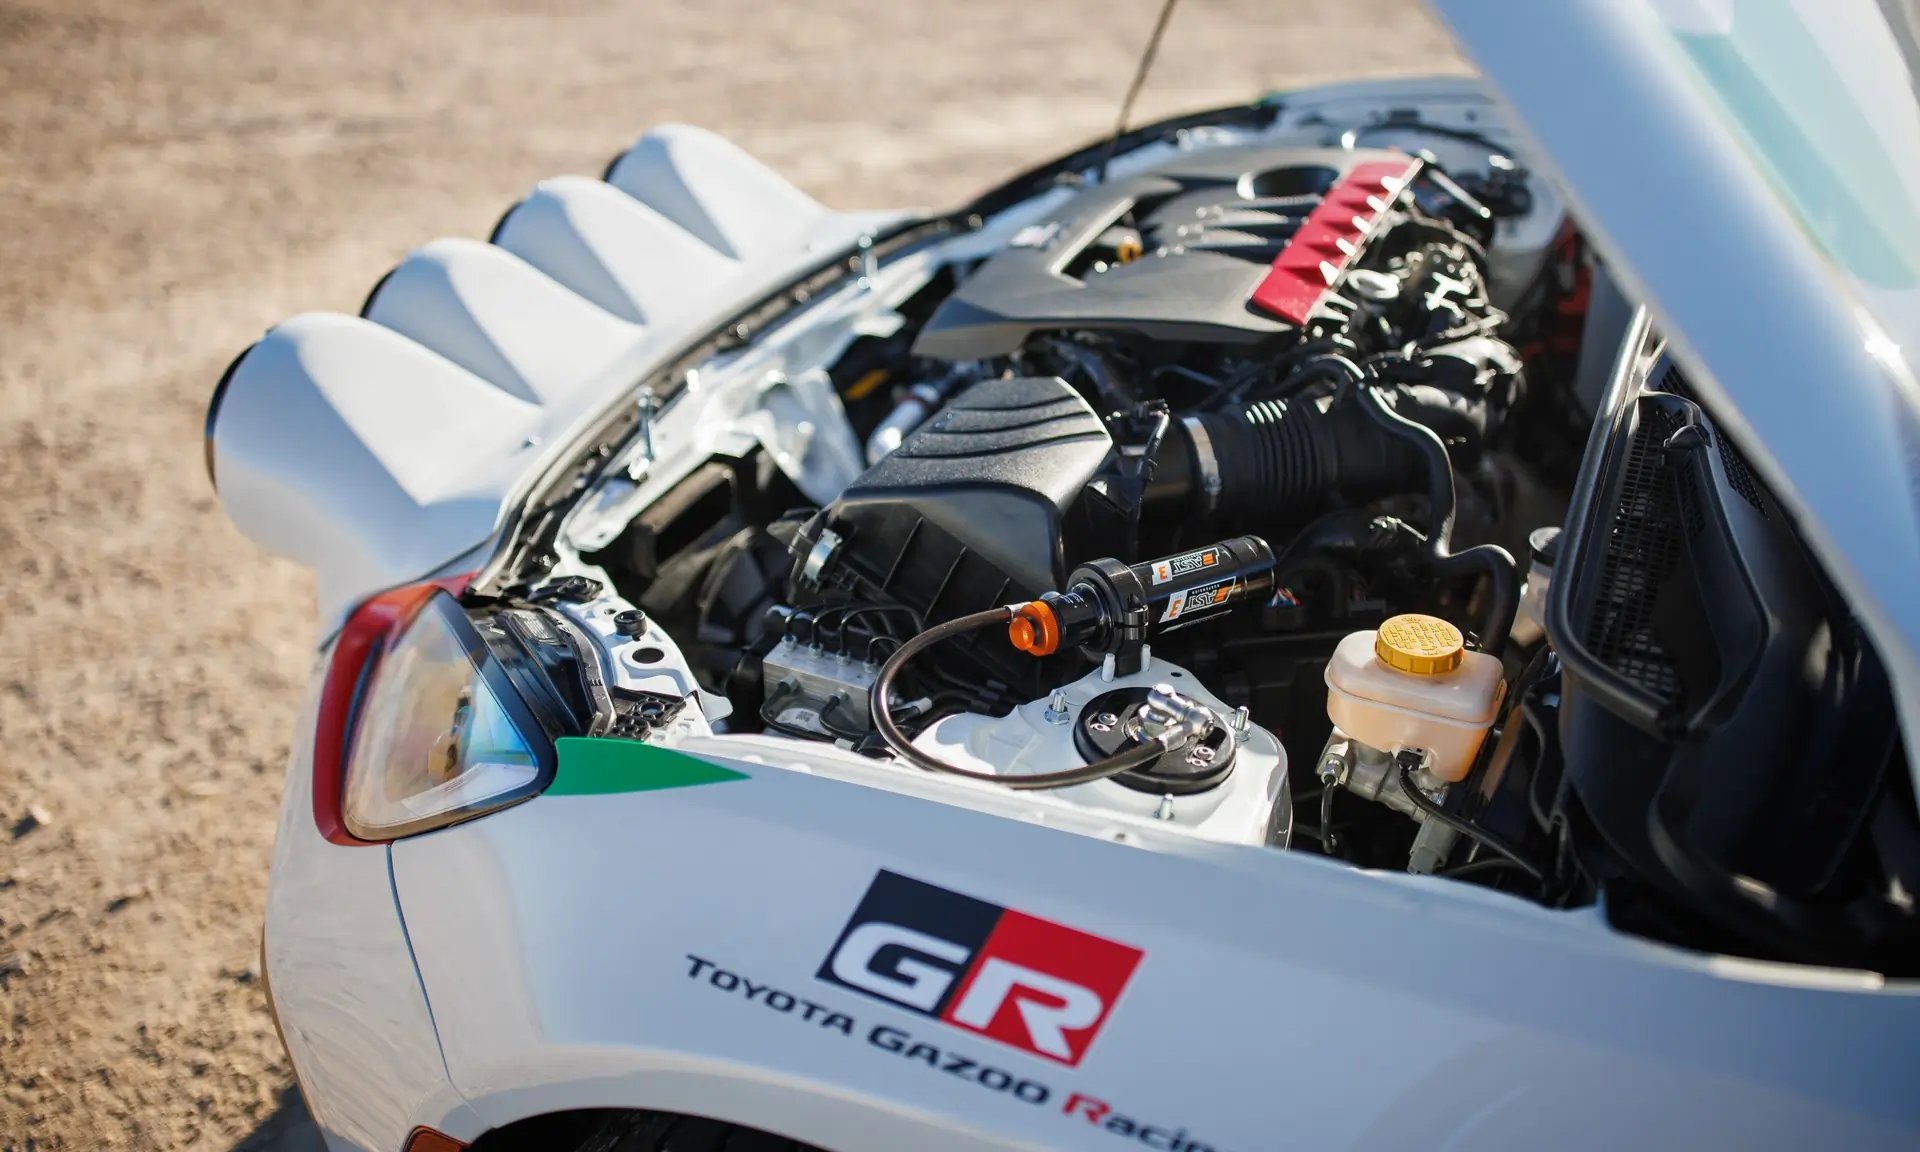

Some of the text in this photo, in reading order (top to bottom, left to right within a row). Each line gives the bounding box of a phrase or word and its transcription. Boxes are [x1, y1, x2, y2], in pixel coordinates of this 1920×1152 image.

[686, 953, 854, 1036] TOYOTA
[867, 1024, 1051, 1106] GAZOO
[831, 921, 1104, 1063] GR
